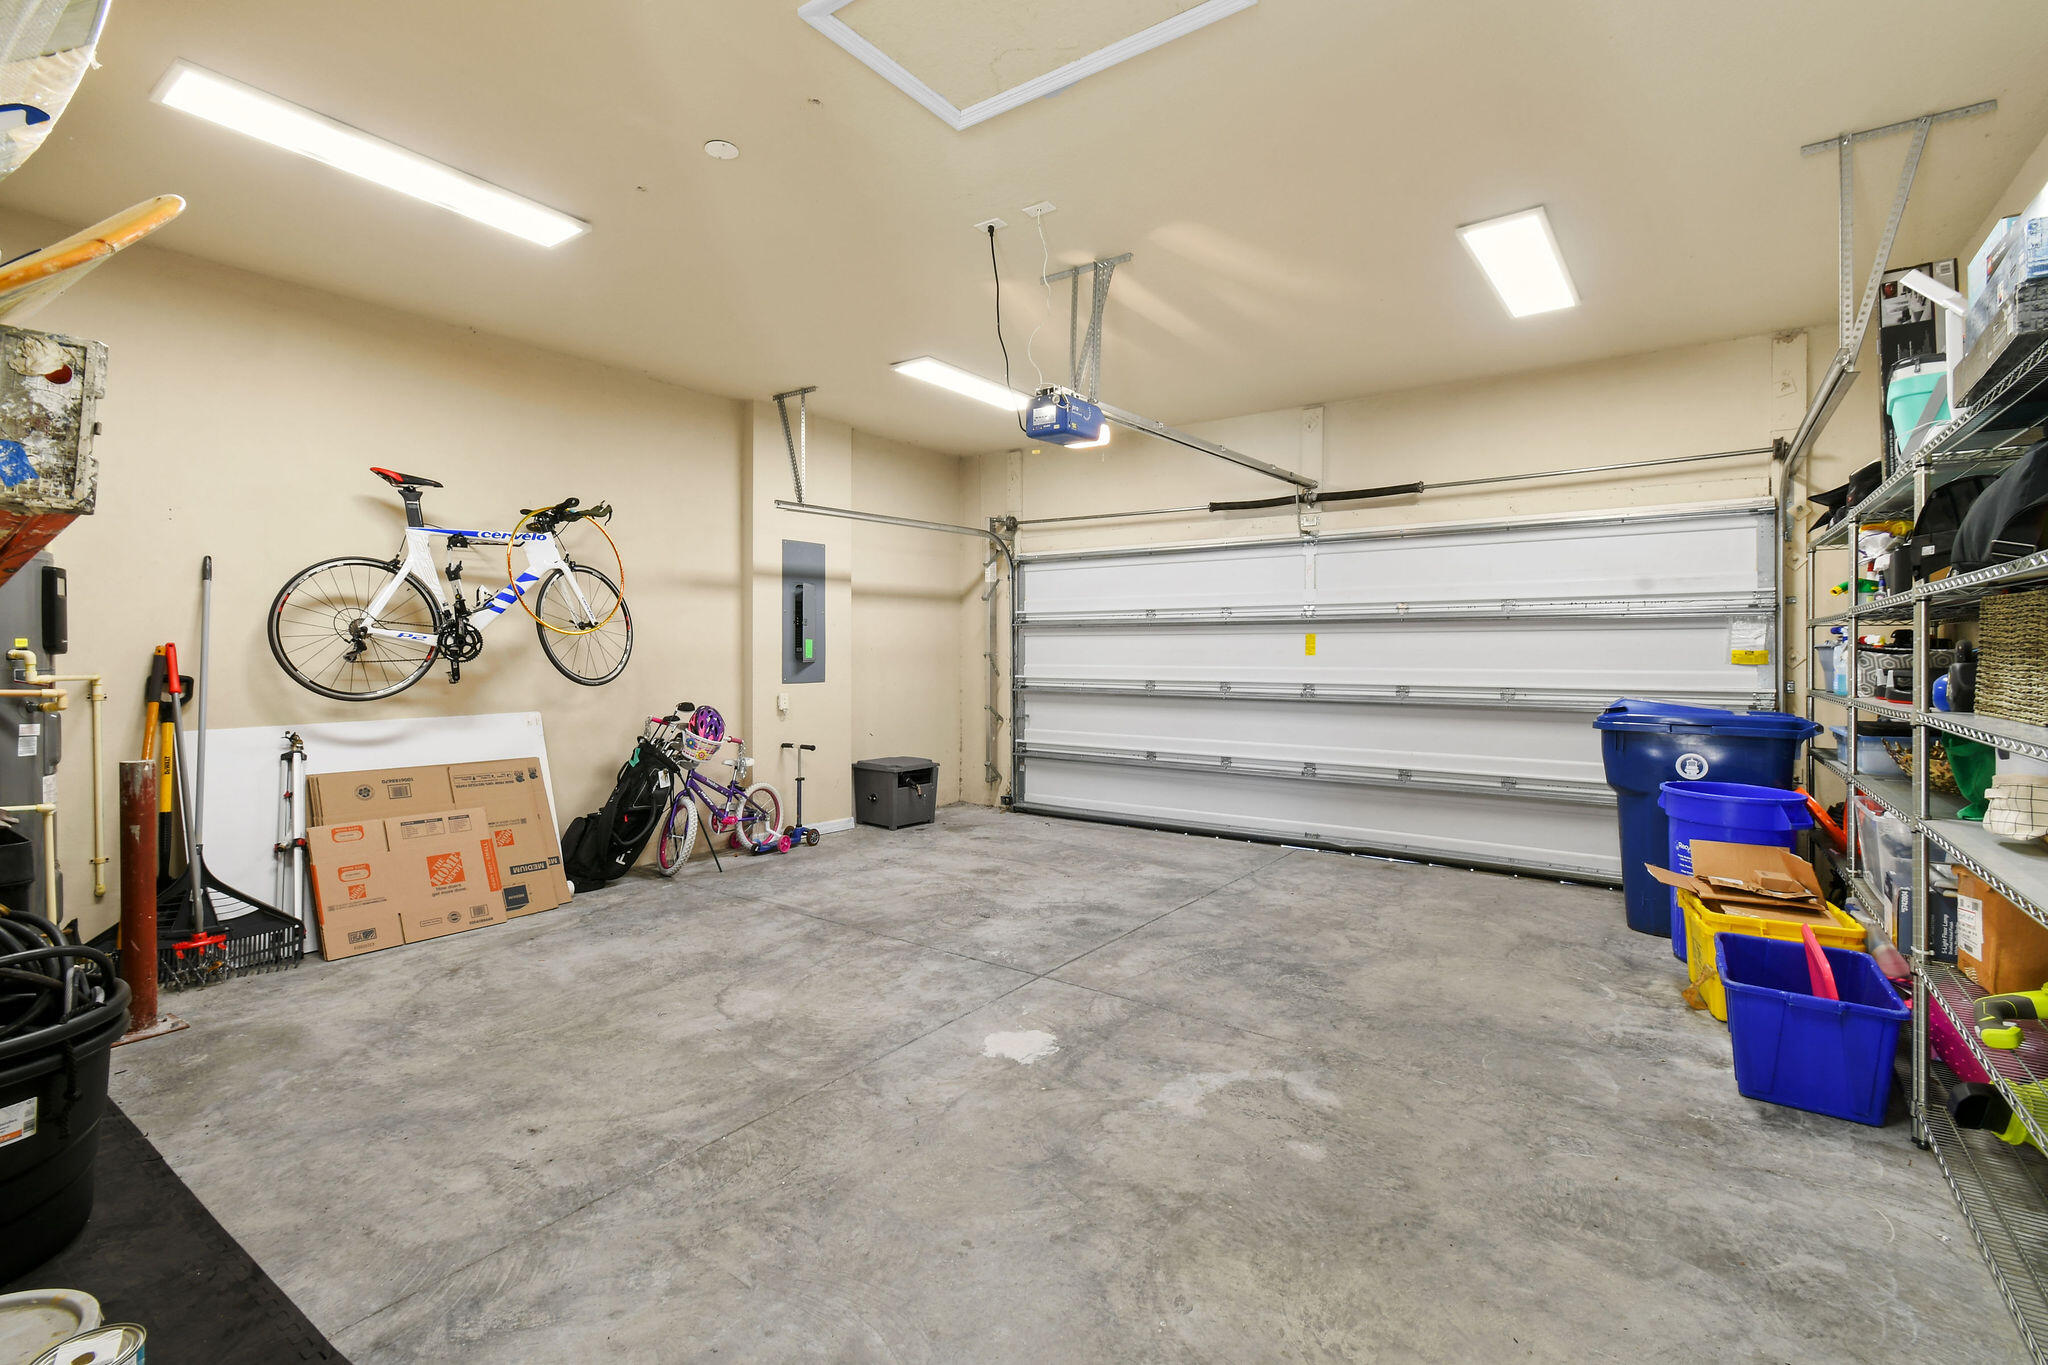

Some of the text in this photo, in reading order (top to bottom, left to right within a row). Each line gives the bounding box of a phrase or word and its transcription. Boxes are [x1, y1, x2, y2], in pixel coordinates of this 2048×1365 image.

[430, 852, 462, 886] HOME
[433, 858, 444, 871] THE
[513, 862, 545, 873] MEDIUM
[444, 863, 464, 884] DEPOT
